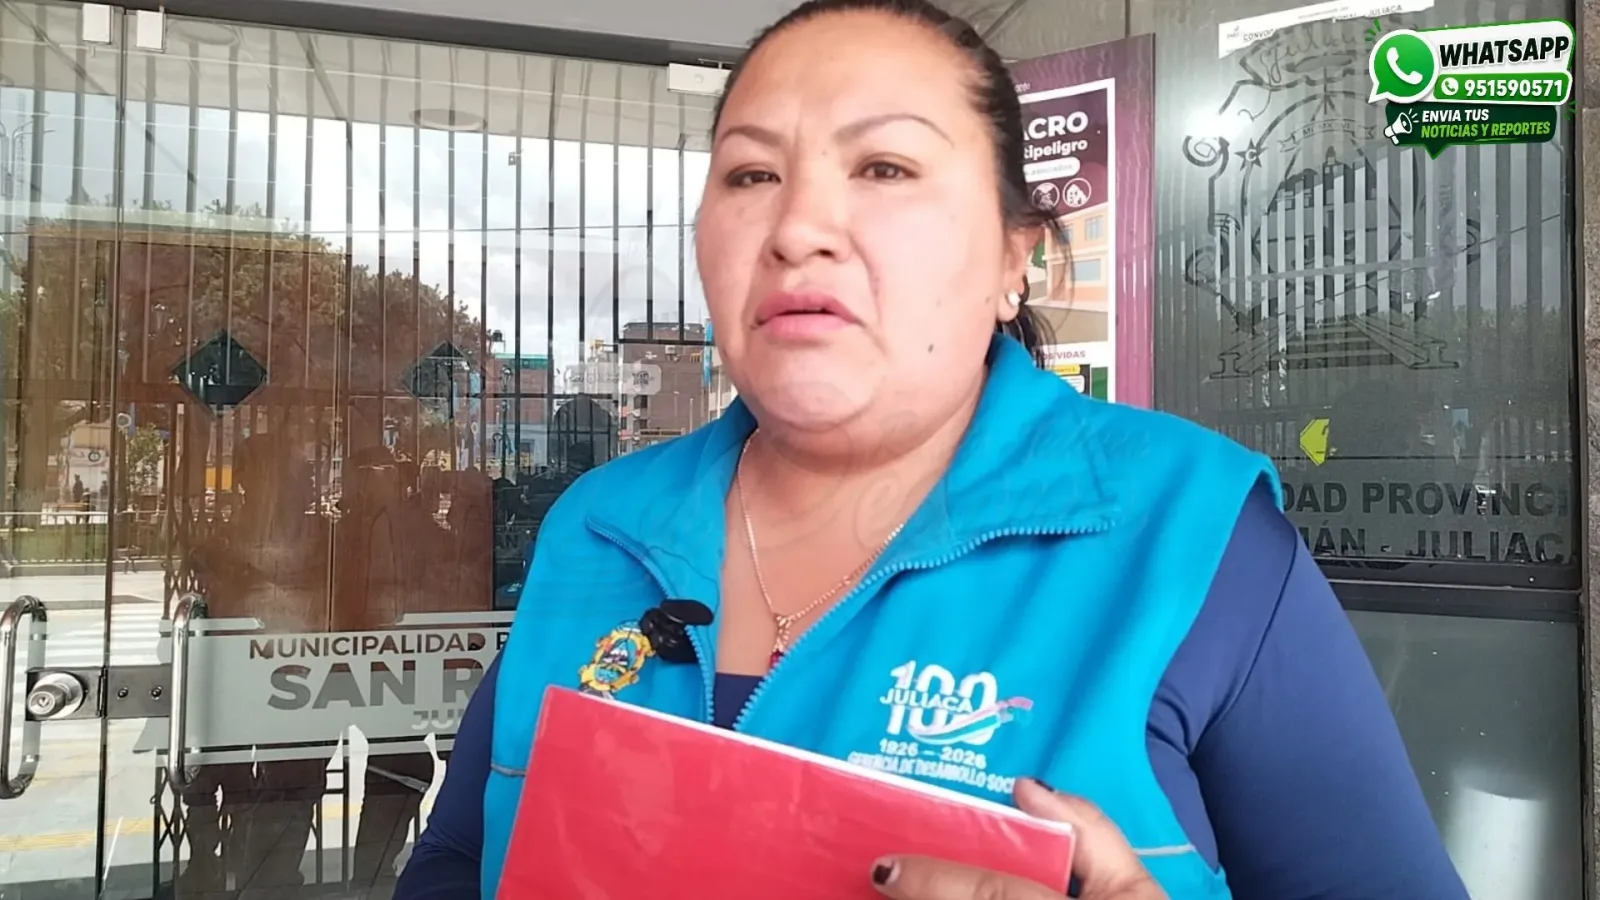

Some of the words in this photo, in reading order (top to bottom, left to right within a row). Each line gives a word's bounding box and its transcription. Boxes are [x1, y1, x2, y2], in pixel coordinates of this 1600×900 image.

[249, 632, 487, 660] MUNICIPALIDAD
[267, 659, 416, 711] SAN
[879, 688, 973, 714] JULIACA
[886, 660, 998, 745] 100
[901, 757, 916, 775] DE
[915, 758, 987, 788] DESARROLLO
[939, 746, 987, 770] 2026
